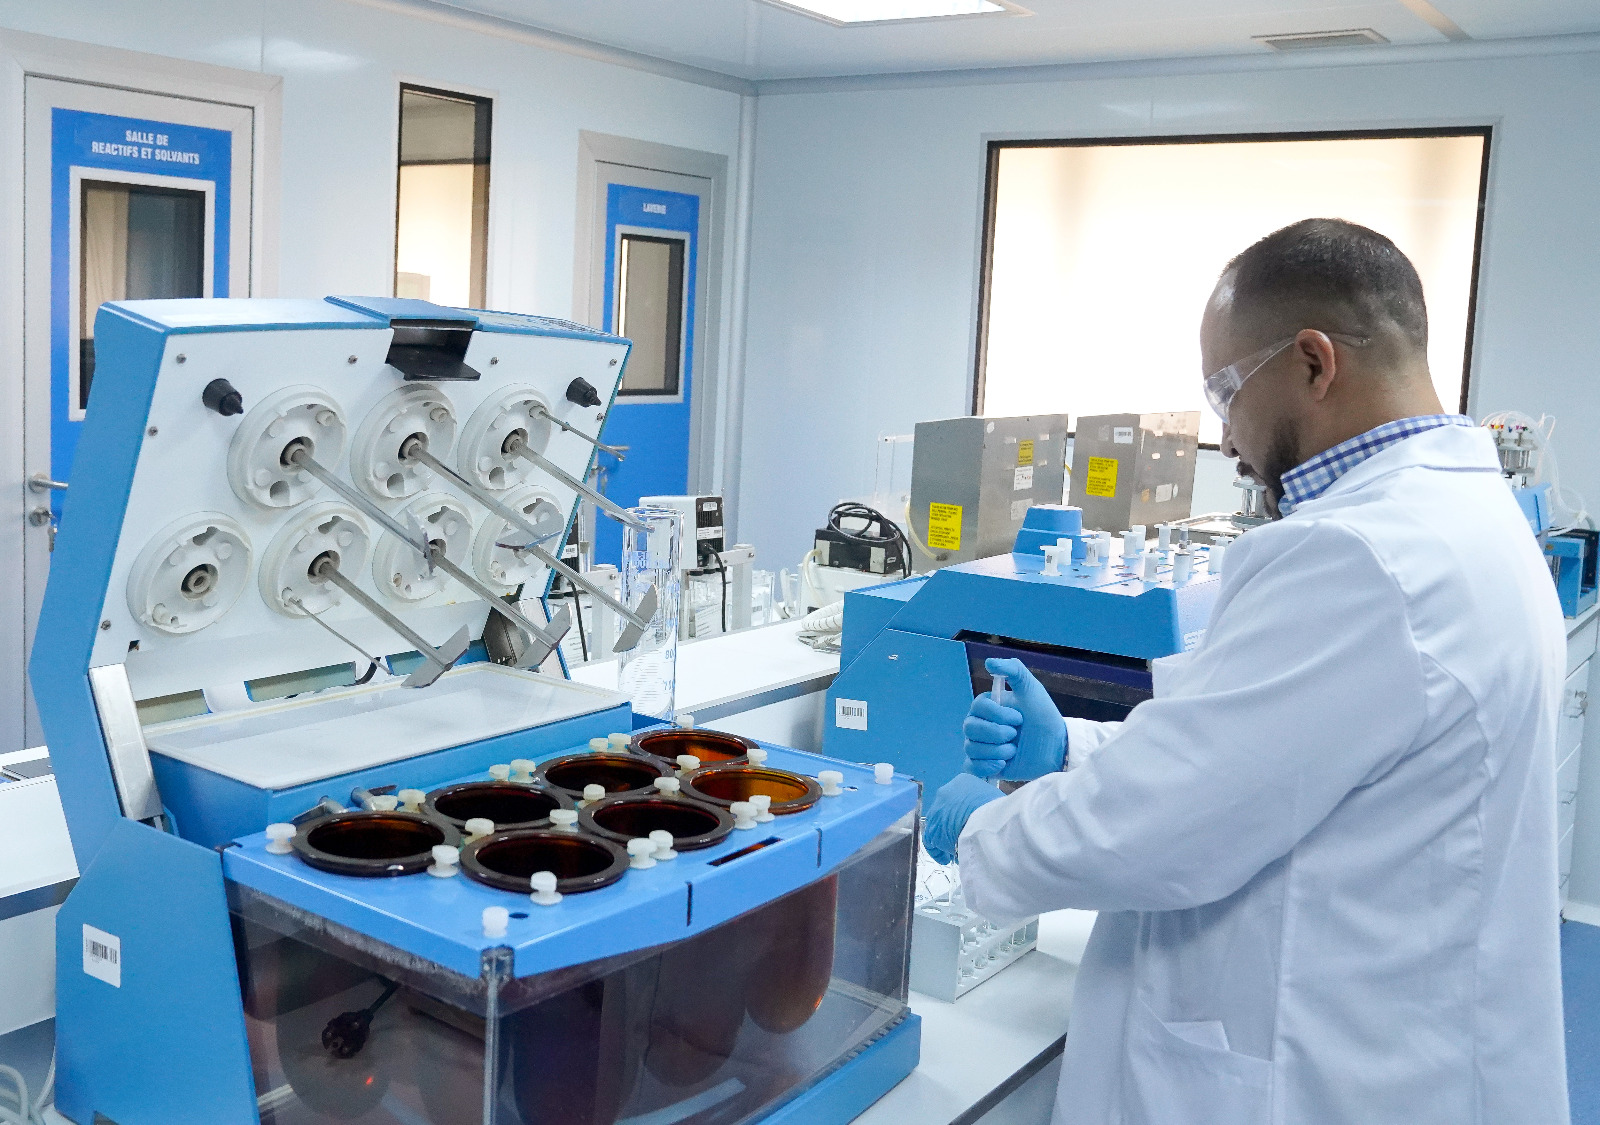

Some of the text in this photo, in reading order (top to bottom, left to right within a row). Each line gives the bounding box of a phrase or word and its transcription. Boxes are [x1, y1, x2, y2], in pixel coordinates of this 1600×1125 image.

[125, 130, 169, 146] SALLE DE
[91, 141, 200, 165] REACTIFS ET SOLVANTS
